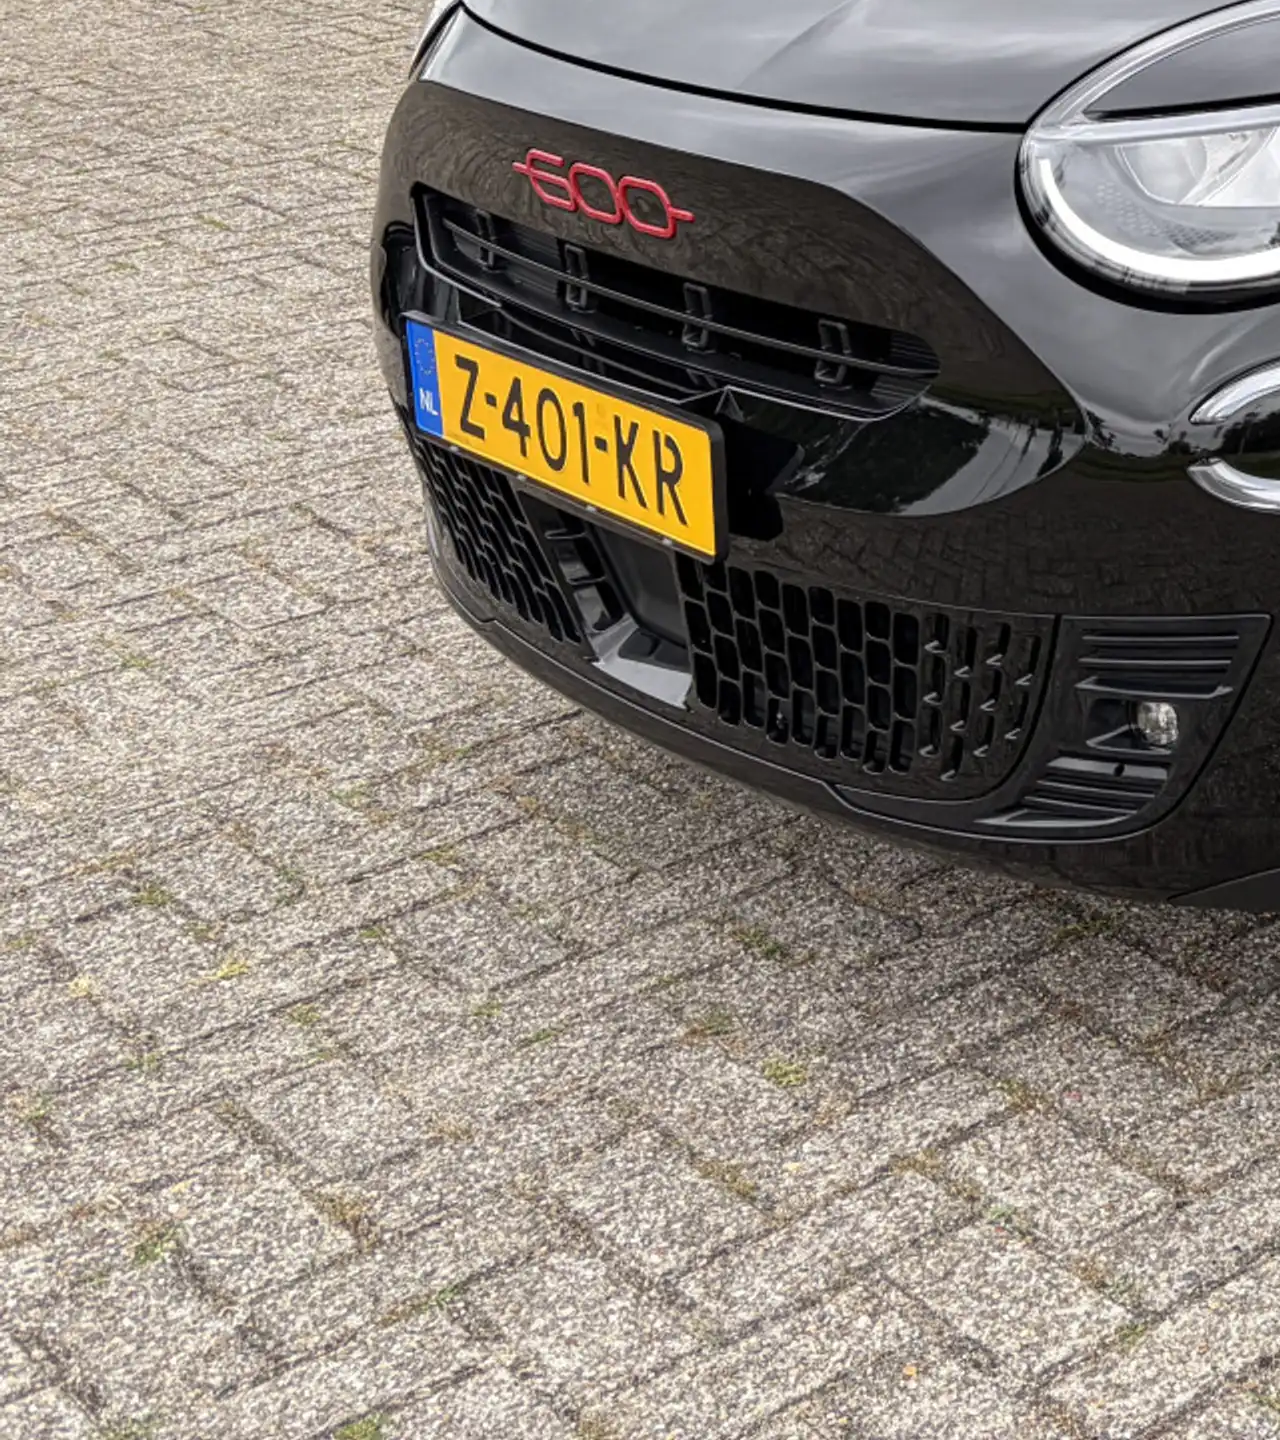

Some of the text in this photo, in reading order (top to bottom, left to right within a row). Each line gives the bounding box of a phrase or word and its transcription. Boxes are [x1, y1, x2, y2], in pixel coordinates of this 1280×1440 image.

[512, 148, 695, 240] 600
[418, 387, 439, 416] NL
[454, 353, 689, 528] Z-401-KR
